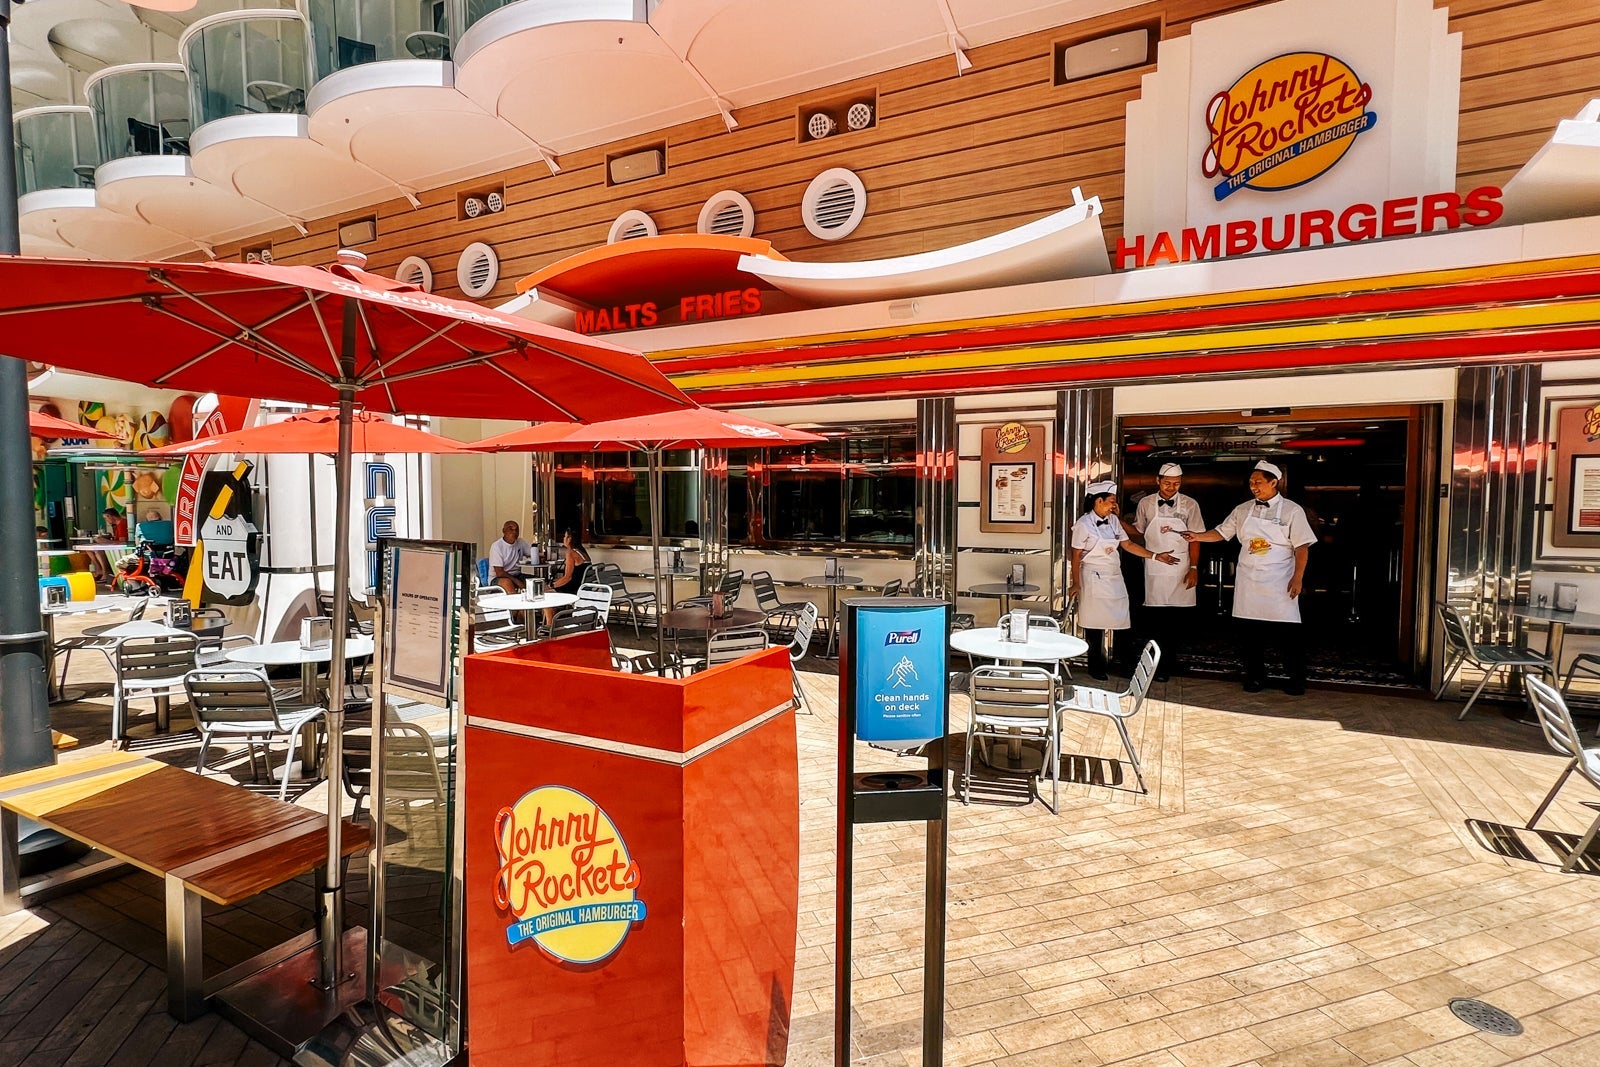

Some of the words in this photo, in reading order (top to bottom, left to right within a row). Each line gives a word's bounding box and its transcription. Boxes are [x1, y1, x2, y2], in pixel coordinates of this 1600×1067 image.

[1202, 55, 1345, 178] Johnny
[1221, 83, 1372, 177] Rockets
[1227, 172, 1247, 190] THE
[1248, 145, 1297, 176] ORIGINAL
[1299, 114, 1368, 154] HAMBURGER
[1115, 186, 1504, 270] HAMBURGERS
[575, 302, 658, 335] MALTS
[680, 287, 762, 321] FRIES
[216, 525, 233, 536] AND
[207, 551, 246, 582] EAT
[874, 694, 901, 702] Clean
[903, 693, 930, 701] hands
[899, 703, 920, 711] deck
[494, 804, 615, 910] Johnny
[512, 849, 641, 917] Rockets
[517, 920, 534, 938] THE
[536, 910, 576, 932] ORIGINAL
[578, 904, 639, 922] HAMBURGER
